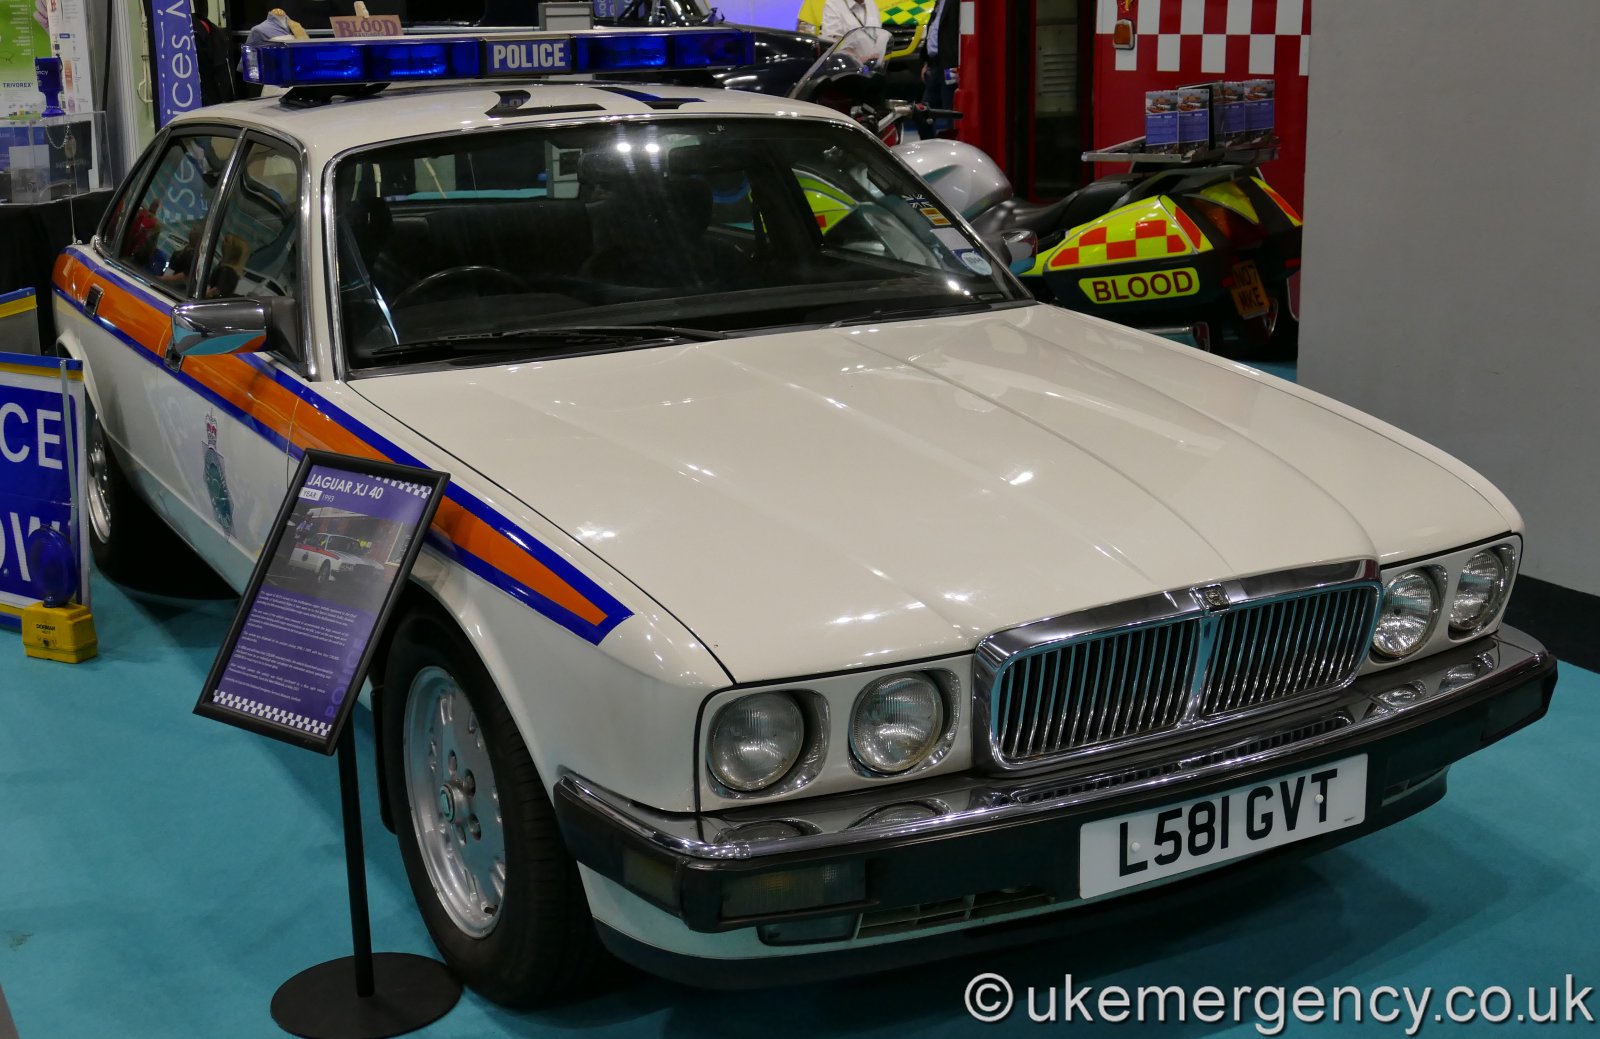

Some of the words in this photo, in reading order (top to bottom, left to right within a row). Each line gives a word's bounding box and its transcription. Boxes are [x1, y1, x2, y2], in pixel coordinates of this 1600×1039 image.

[336, 19, 398, 37] BLOOD
[493, 43, 566, 69] POLICE
[1092, 270, 1193, 302] BLOOD
[307, 474, 353, 493] JAGUAR
[353, 482, 369, 497] XJ
[369, 486, 384, 500] 40
[1119, 795, 1230, 877] L581
[1246, 767, 1338, 841] GVT
